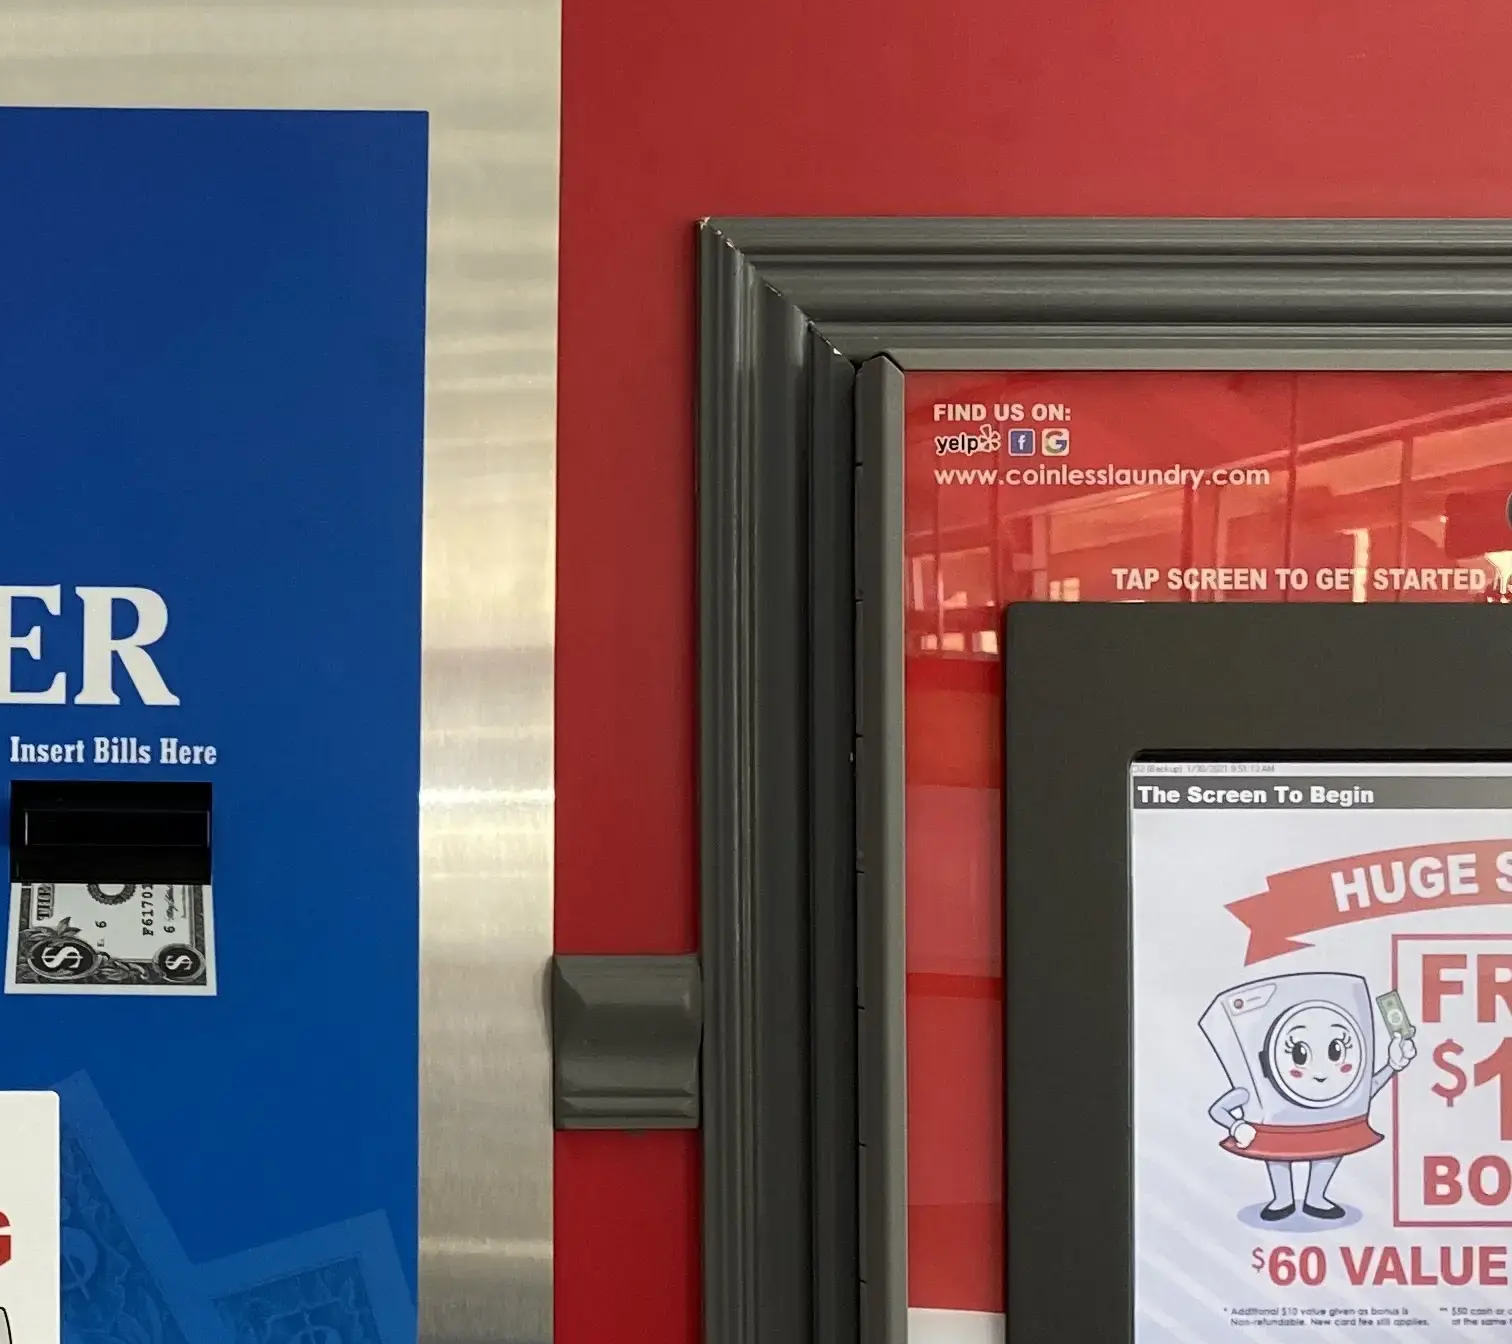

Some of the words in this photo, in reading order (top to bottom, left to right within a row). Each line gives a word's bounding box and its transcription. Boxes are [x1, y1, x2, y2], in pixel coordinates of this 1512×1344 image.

[933, 403, 986, 421] FIND
[994, 403, 1024, 421] US
[1031, 403, 1071, 422] ON:
[935, 433, 979, 456] yelp
[933, 464, 1270, 491] www.coinlesslaundry.com
[1112, 569, 1160, 589] TAP
[1167, 569, 1267, 590] SCREEN
[1274, 569, 1308, 590] TO
[1316, 569, 1362, 590] GET
[1374, 569, 1486, 590] STARTED
[10, 736, 85, 763] Insert
[94, 737, 152, 764] Bills
[160, 738, 217, 765] Here
[1137, 785, 1180, 804] The
[1187, 785, 1267, 804] Screen
[1273, 785, 1303, 804] To
[1310, 785, 1375, 806] Begin
[1330, 853, 1480, 912] HUGE
[1251, 1247, 1326, 1286] $60
[1339, 1245, 1508, 1287] VALUE
